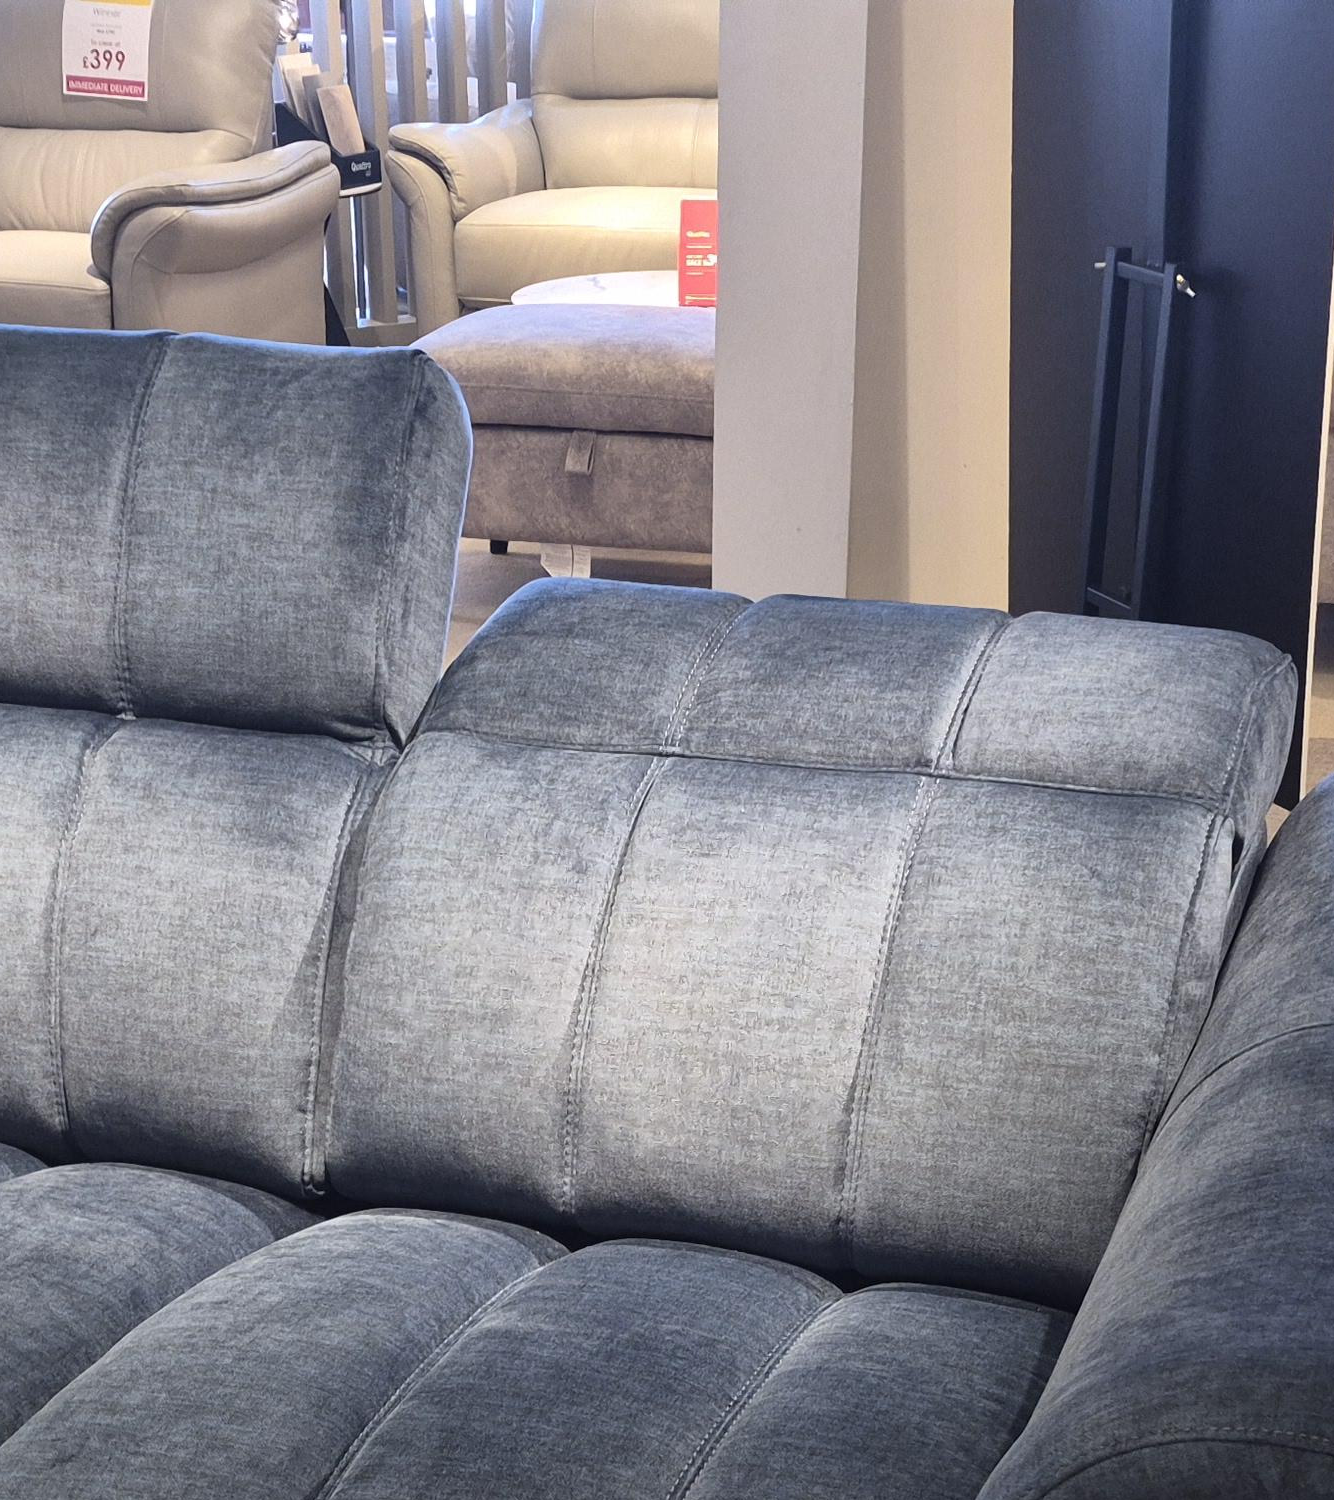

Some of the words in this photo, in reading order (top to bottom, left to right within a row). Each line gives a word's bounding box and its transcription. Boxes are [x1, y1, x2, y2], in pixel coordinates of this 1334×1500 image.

[83, 49, 125, 71] £399
[68, 80, 108, 91] IMMEDIATE
[109, 84, 143, 95] DELIVERY
